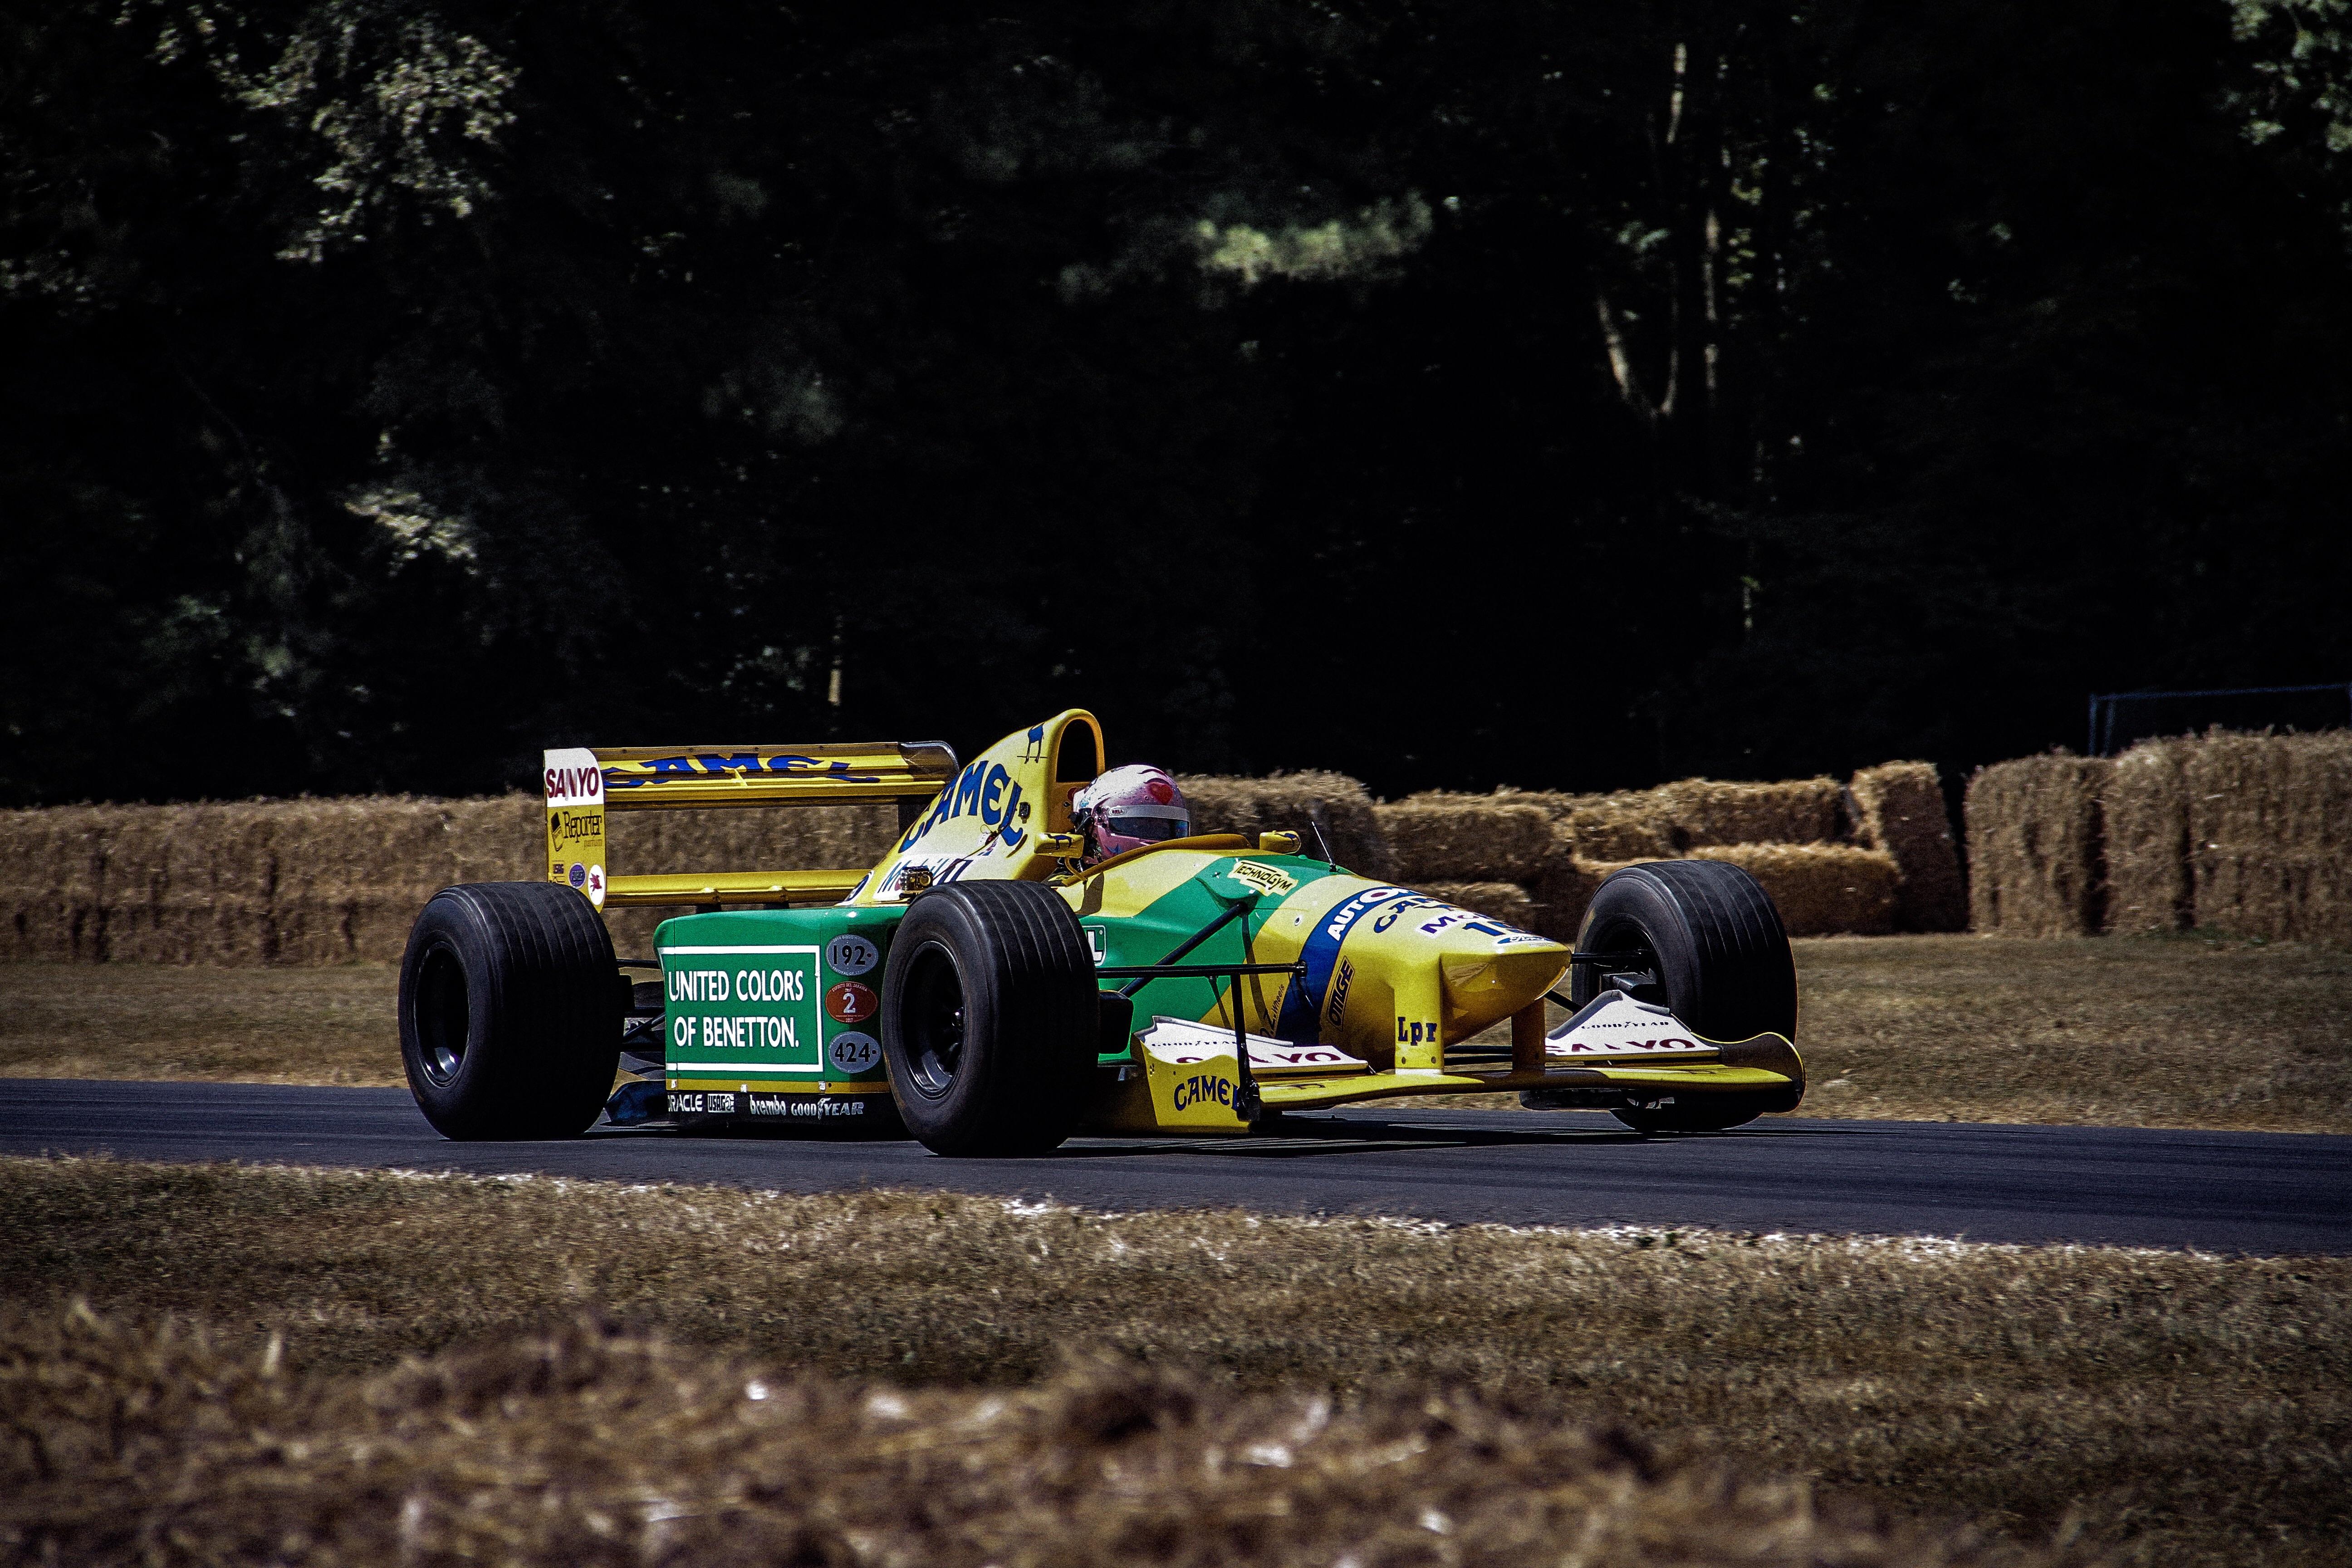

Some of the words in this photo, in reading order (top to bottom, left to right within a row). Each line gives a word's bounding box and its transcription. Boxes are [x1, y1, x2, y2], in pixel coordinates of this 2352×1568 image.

[546, 767, 599, 799] SANYO
[898, 760, 1023, 847] CAMEL
[563, 810, 602, 843] Reporter
[833, 945, 866, 965] 192
[668, 970, 729, 1002] UNITED
[736, 970, 804, 1001] COLORS
[843, 993, 856, 1013] 2
[675, 1016, 697, 1046] OF
[703, 1016, 799, 1048] BENETTON.
[834, 1042, 871, 1063] 424
[708, 1095, 726, 1112] USAG
[750, 1094, 786, 1116] brembo
